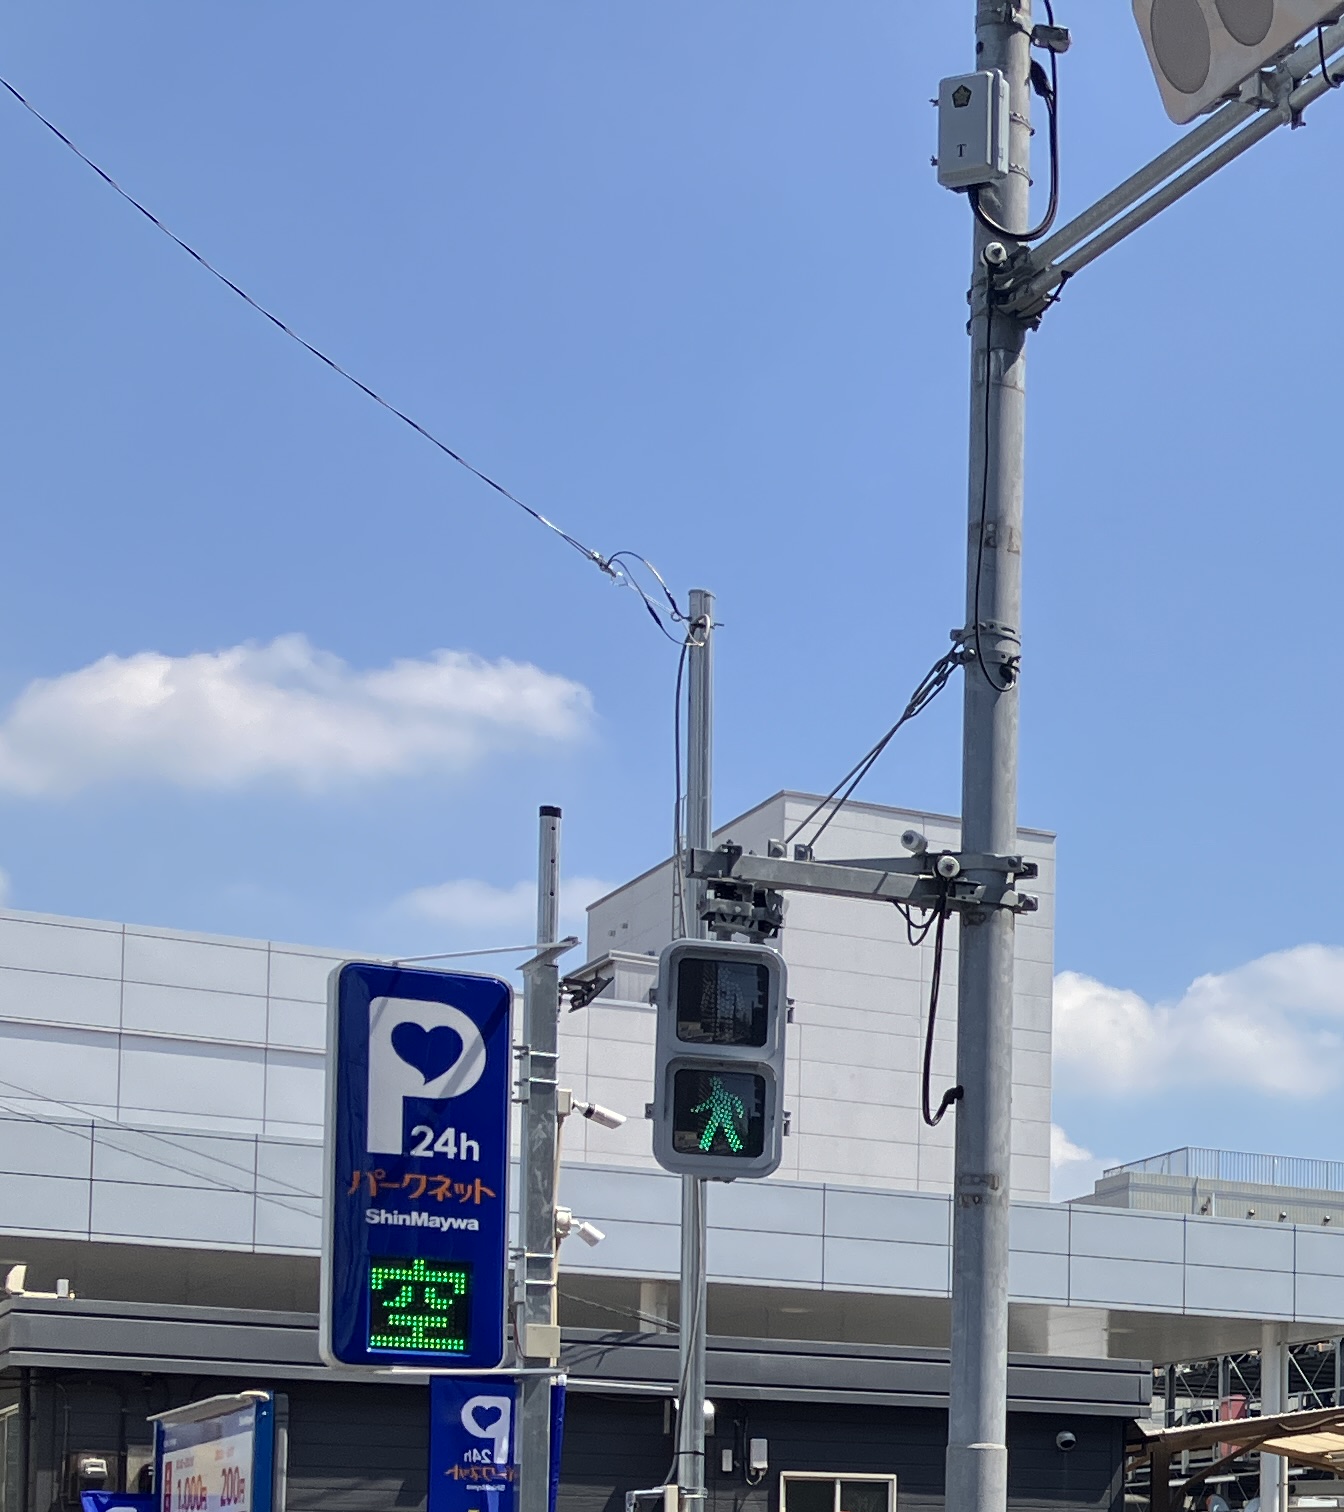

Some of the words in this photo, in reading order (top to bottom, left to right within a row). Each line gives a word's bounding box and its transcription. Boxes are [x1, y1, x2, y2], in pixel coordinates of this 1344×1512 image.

[956, 143, 967, 157] T
[367, 997, 486, 1155] P
[409, 1125, 480, 1161] 24h
[347, 1168, 497, 1205] パークネット
[365, 1208, 480, 1232] ShinMaywa
[370, 1259, 467, 1351] 空
